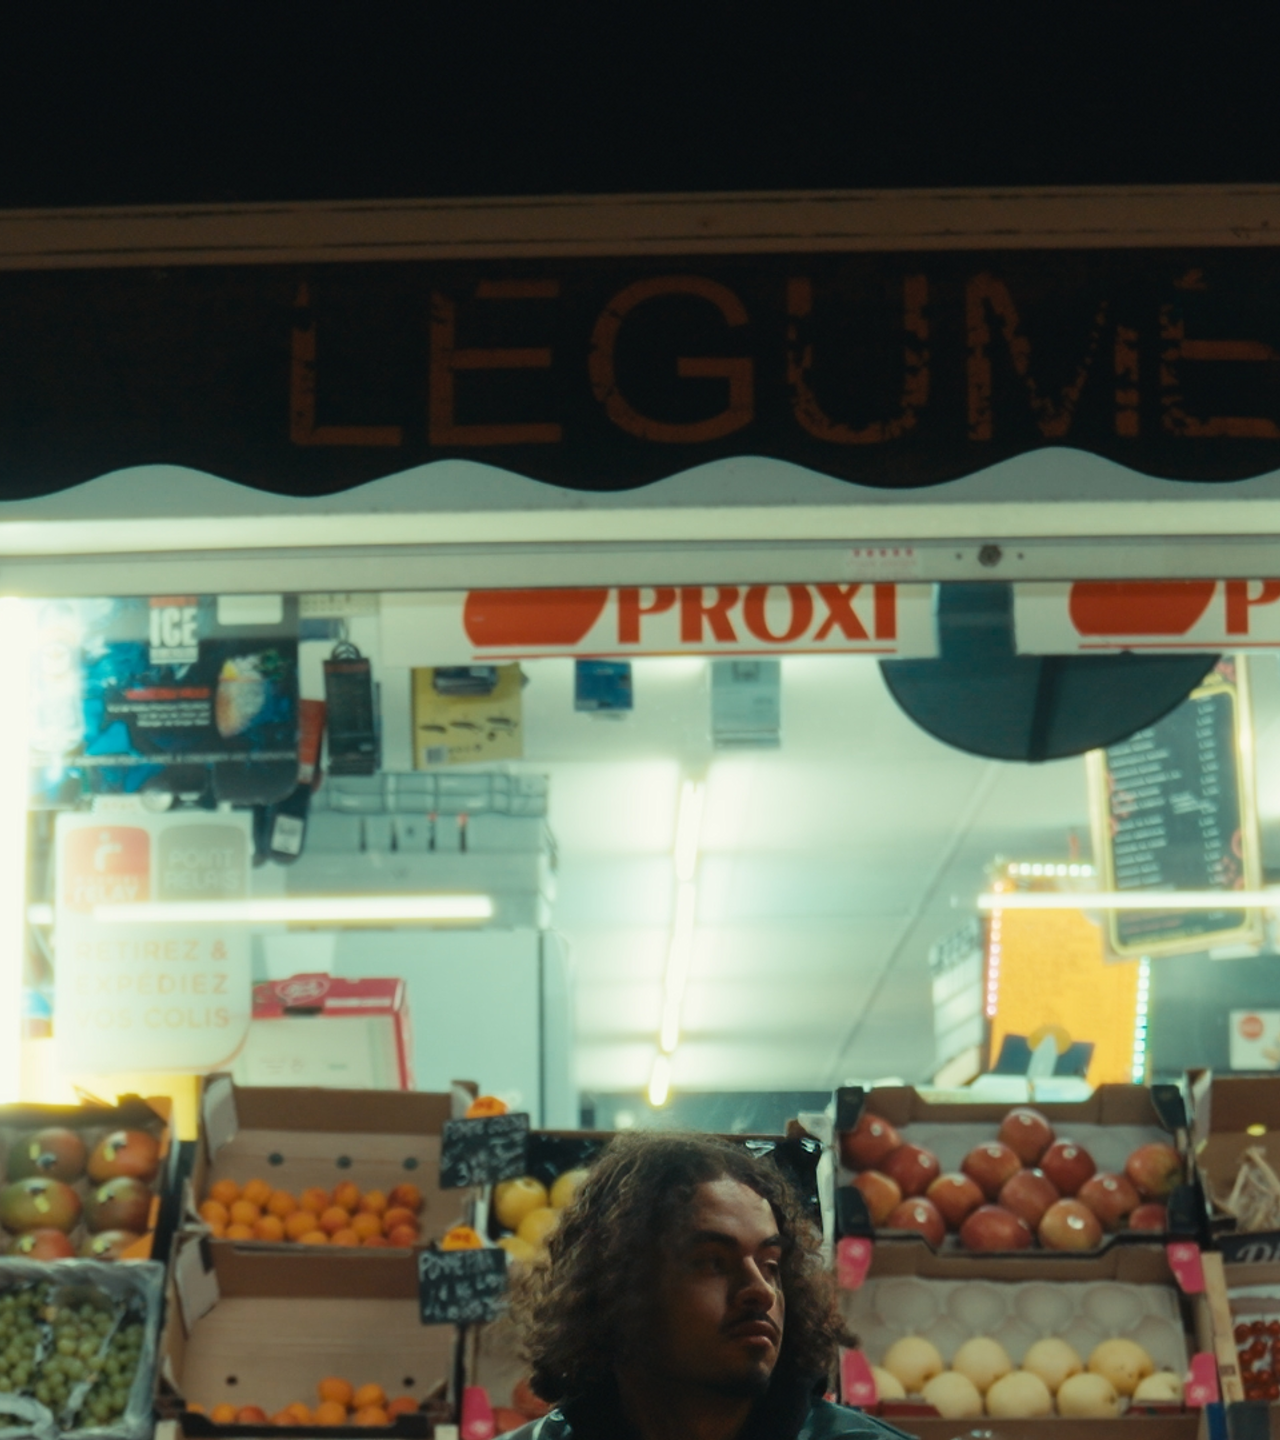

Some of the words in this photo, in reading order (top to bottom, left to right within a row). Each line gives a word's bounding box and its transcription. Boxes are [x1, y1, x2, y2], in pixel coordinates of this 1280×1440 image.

[149, 606, 198, 647] ICE
[617, 582, 898, 646] PROXI
[76, 938, 201, 961] RETIREZ
[209, 936, 229, 961] &
[76, 1007, 133, 1030] VOS
[143, 1005, 231, 1031] COLIS
